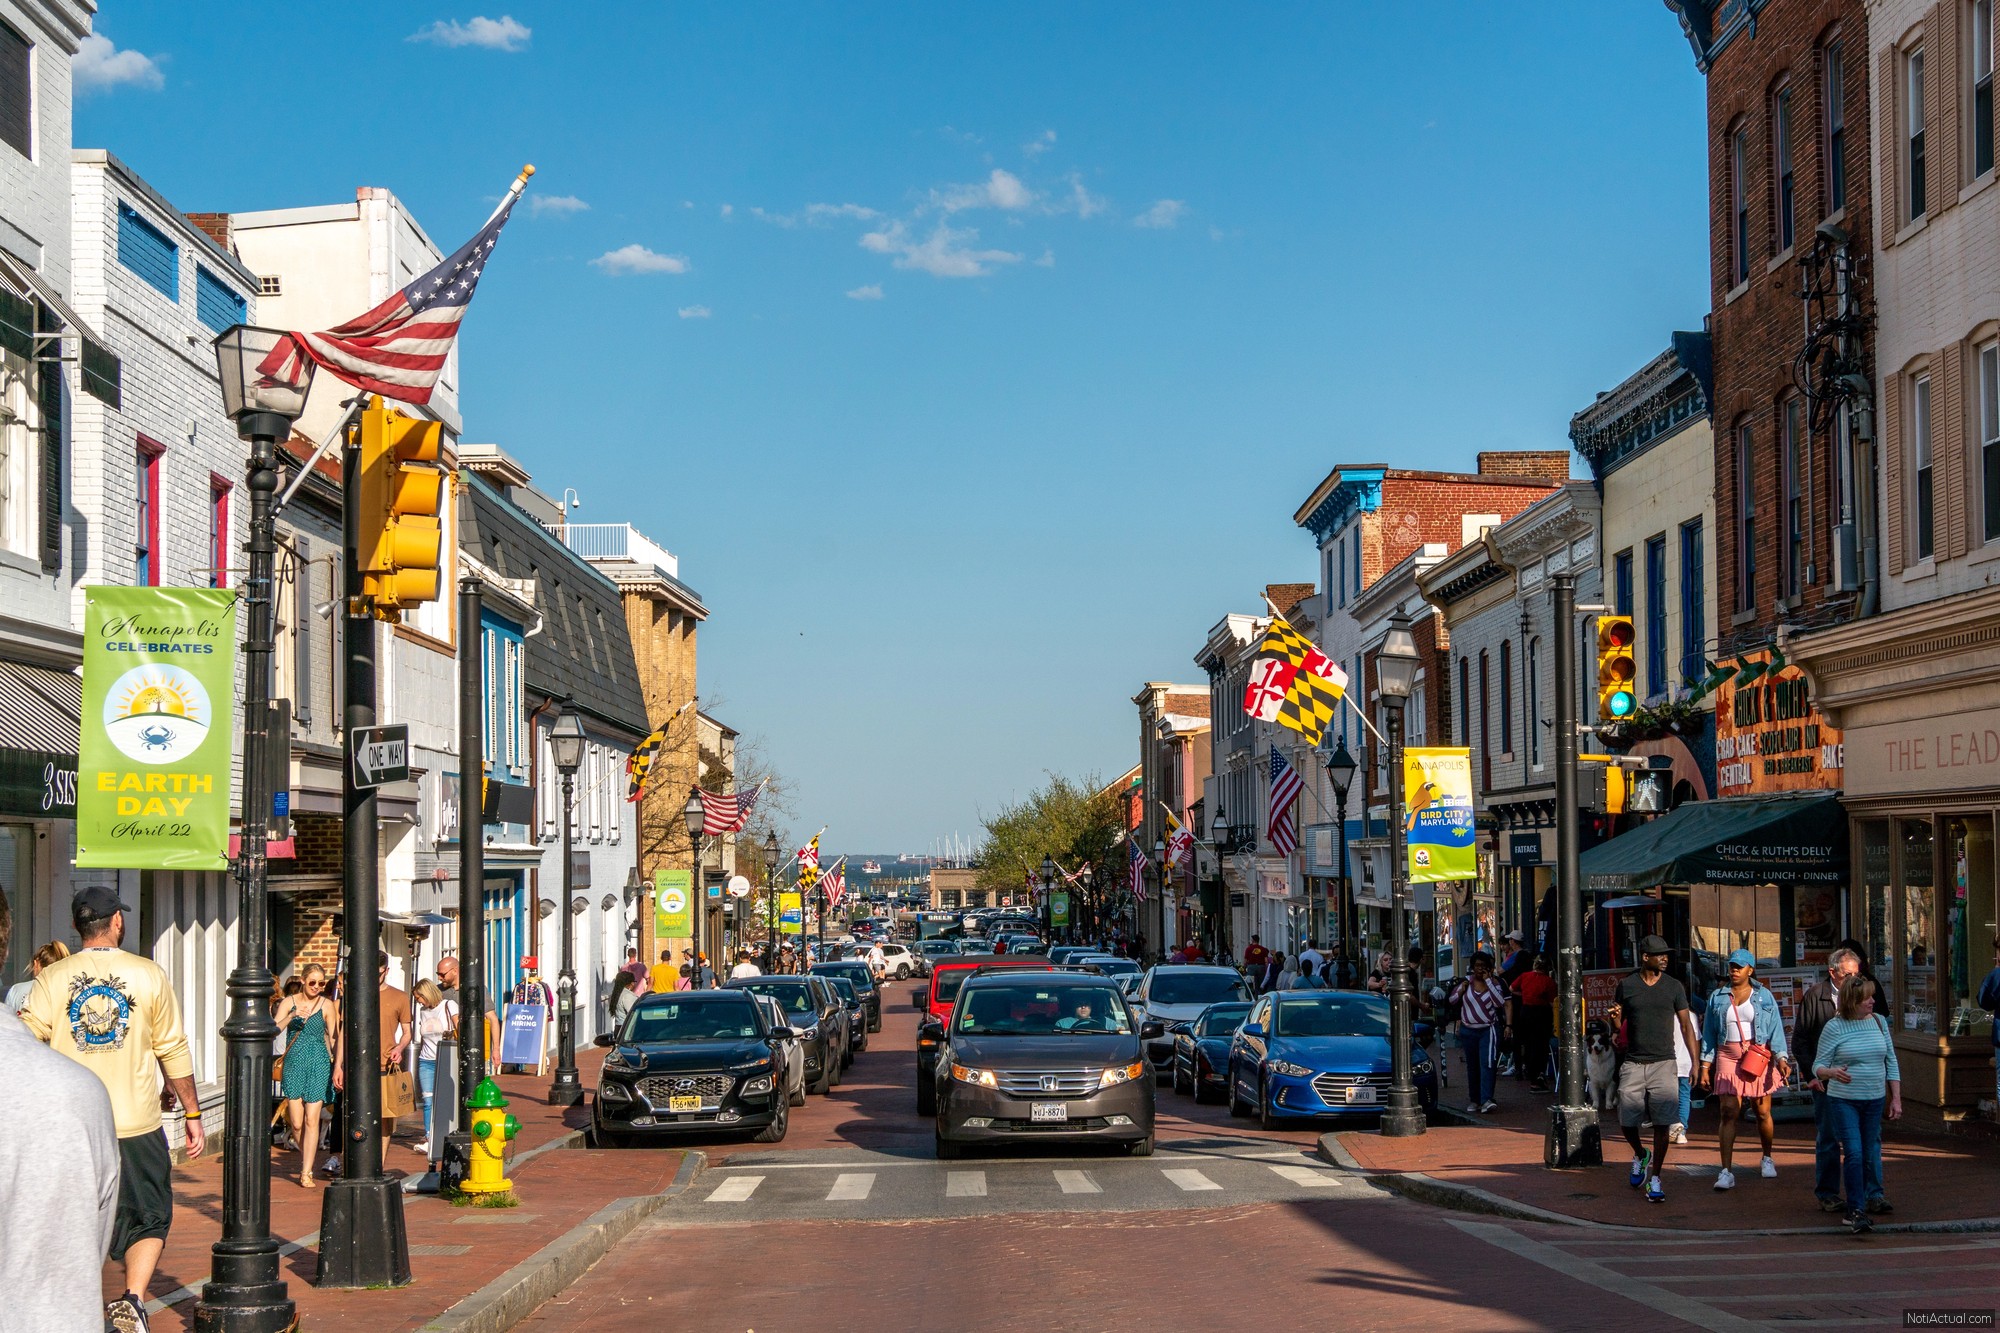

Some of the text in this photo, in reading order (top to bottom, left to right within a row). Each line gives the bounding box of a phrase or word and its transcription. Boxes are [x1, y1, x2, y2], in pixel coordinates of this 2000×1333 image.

[101, 614, 220, 642] Annapolis
[105, 641, 213, 654] CELEBRATES
[1734, 687, 1758, 728] CHICK
[1764, 685, 1772, 722] &
[1716, 733, 1756, 761] CRAB CAKE
[1805, 724, 1820, 750] INN
[368, 743, 404, 768] ONE WAY
[1884, 729, 2000, 772] THE LEAD
[1410, 761, 1465, 771] ANNAPOLIS
[1720, 762, 1752, 788] CENTRAL
[42, 762, 79, 810] 3 SIS
[97, 771, 213, 794] EARTH
[117, 796, 193, 817] DAY
[1420, 809, 1465, 819] BIRD CITY
[111, 820, 192, 840] April 22
[1420, 818, 1463, 827] MARYLAND
[1514, 845, 1538, 854] FATFACE
[1716, 844, 1832, 856] CHICK & RUTH'S DELLY
[1706, 870, 1839, 880] BREAKFAST LUNCH DINNER
